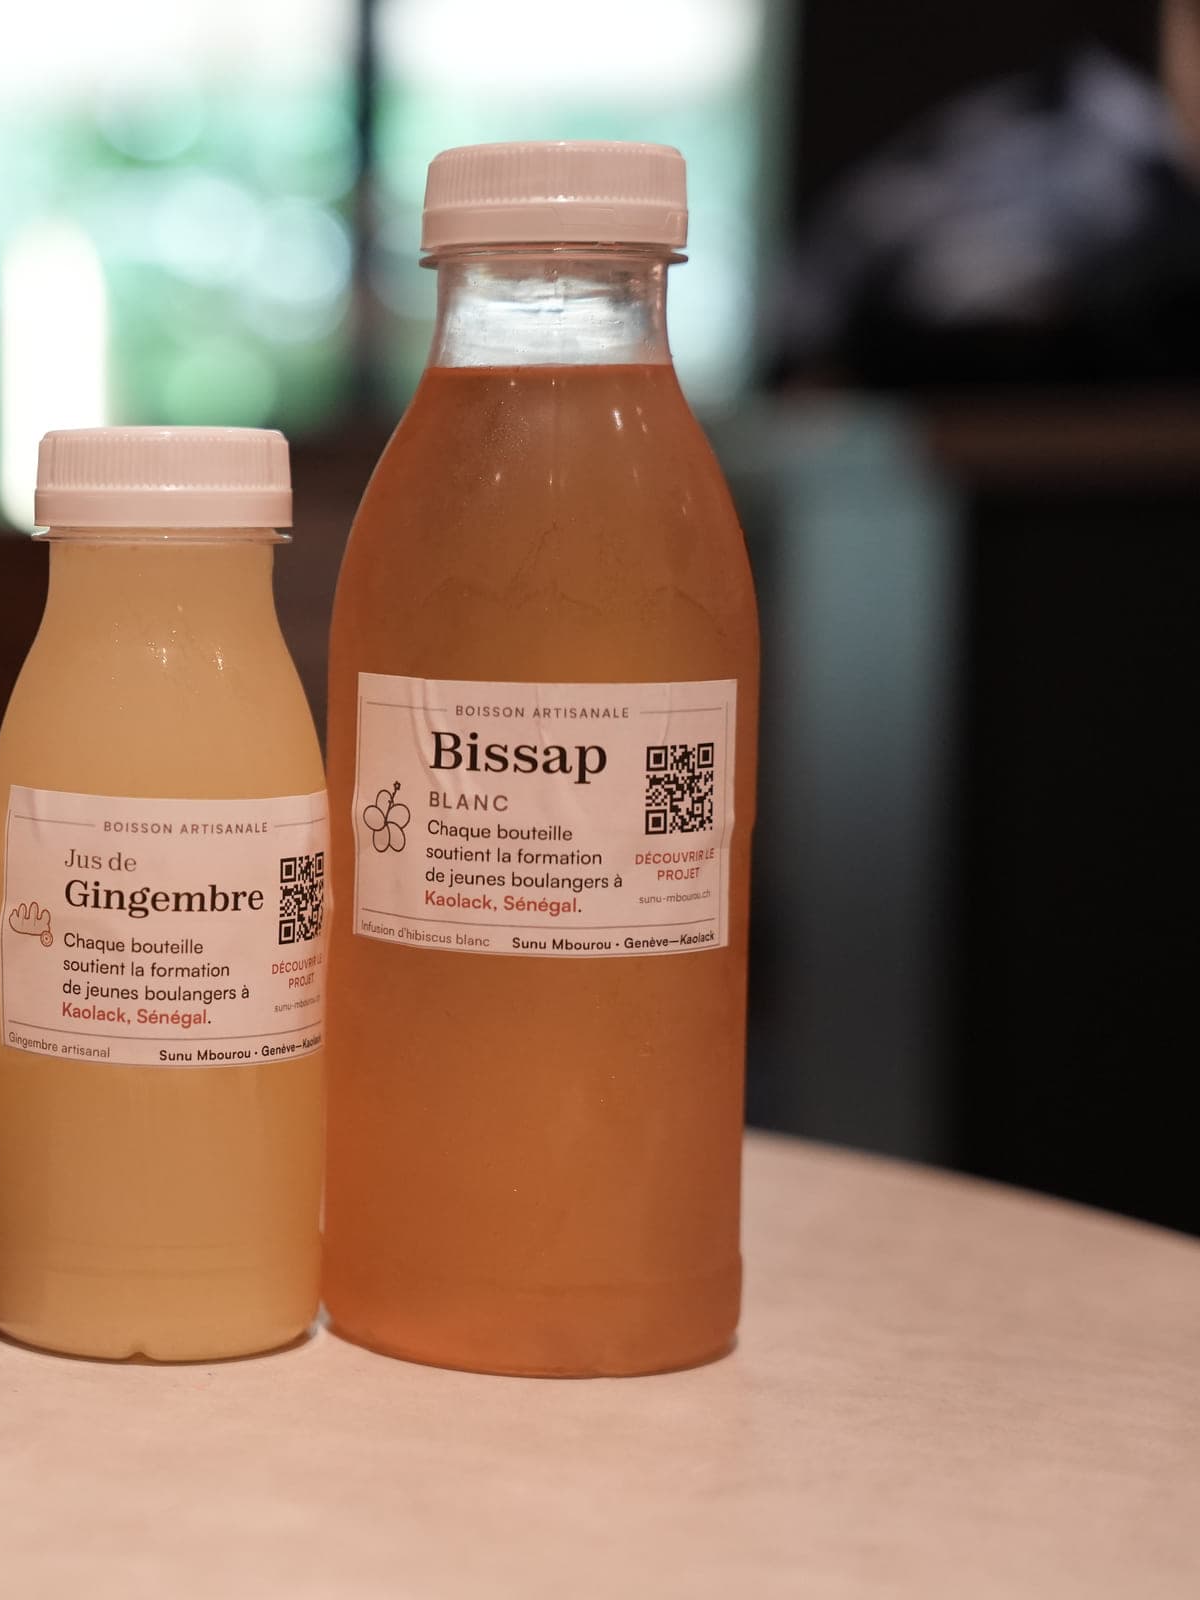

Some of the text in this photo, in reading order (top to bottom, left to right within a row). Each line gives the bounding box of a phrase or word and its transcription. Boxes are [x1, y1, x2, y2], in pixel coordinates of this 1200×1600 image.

[456, 705, 628, 719] BOISSON ARTISANALE
[429, 731, 607, 784] Bissap
[429, 791, 508, 812] BLANC
[104, 821, 267, 834] BOISSON ARTISANALE
[428, 819, 572, 841] Chaque bouteille
[65, 849, 136, 872] Jus de
[426, 846, 602, 865] soutient la formation
[635, 848, 714, 865] DÉCOUVRIR LE
[425, 868, 622, 893] de jeunes boulangers à
[657, 867, 700, 880] PROJET
[65, 880, 264, 918] Gingembre
[425, 890, 582, 917] Kaolack, Sénégal.
[64, 933, 203, 954] Chaque bouteille
[361, 920, 395, 936] Infusion
[456, 933, 490, 947] blanc
[513, 937, 546, 949] Sunu
[552, 936, 611, 950] Mbourou
[63, 959, 229, 978] soutient la formation
[289, 972, 314, 989] PROJET
[63, 980, 249, 1005] de jeunes boulangers à
[62, 1001, 211, 1029] Kaolack, Sénégal.
[9, 1032, 110, 1058] Gingembre artisanal
[160, 1050, 192, 1061] Sunu
[197, 1047, 251, 1061] Mbourou
